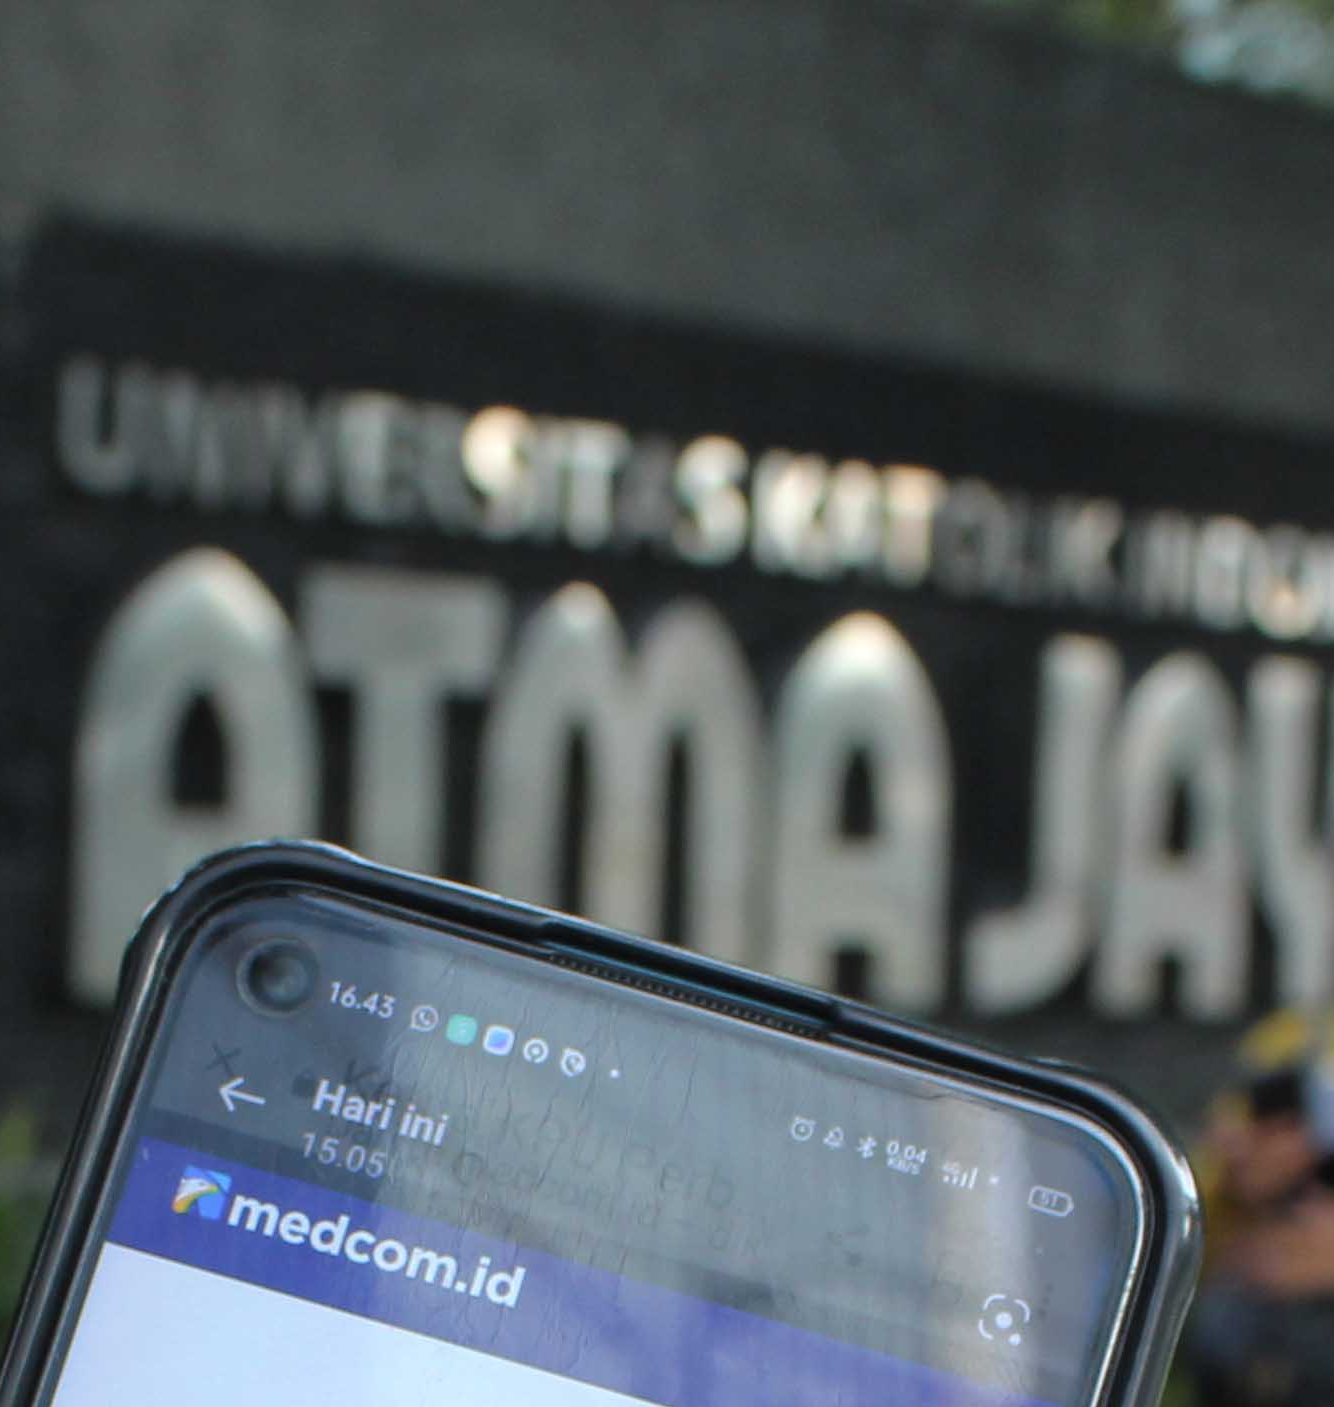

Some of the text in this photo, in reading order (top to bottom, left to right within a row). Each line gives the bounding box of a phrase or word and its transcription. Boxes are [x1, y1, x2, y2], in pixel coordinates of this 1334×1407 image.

[62, 357, 750, 568] UNIVERSITAS
[71, 545, 954, 1010] ATMA
[330, 981, 395, 1018] 16.43
[312, 1078, 450, 1147] Hari ini
[227, 1194, 527, 1308] medcom.id
